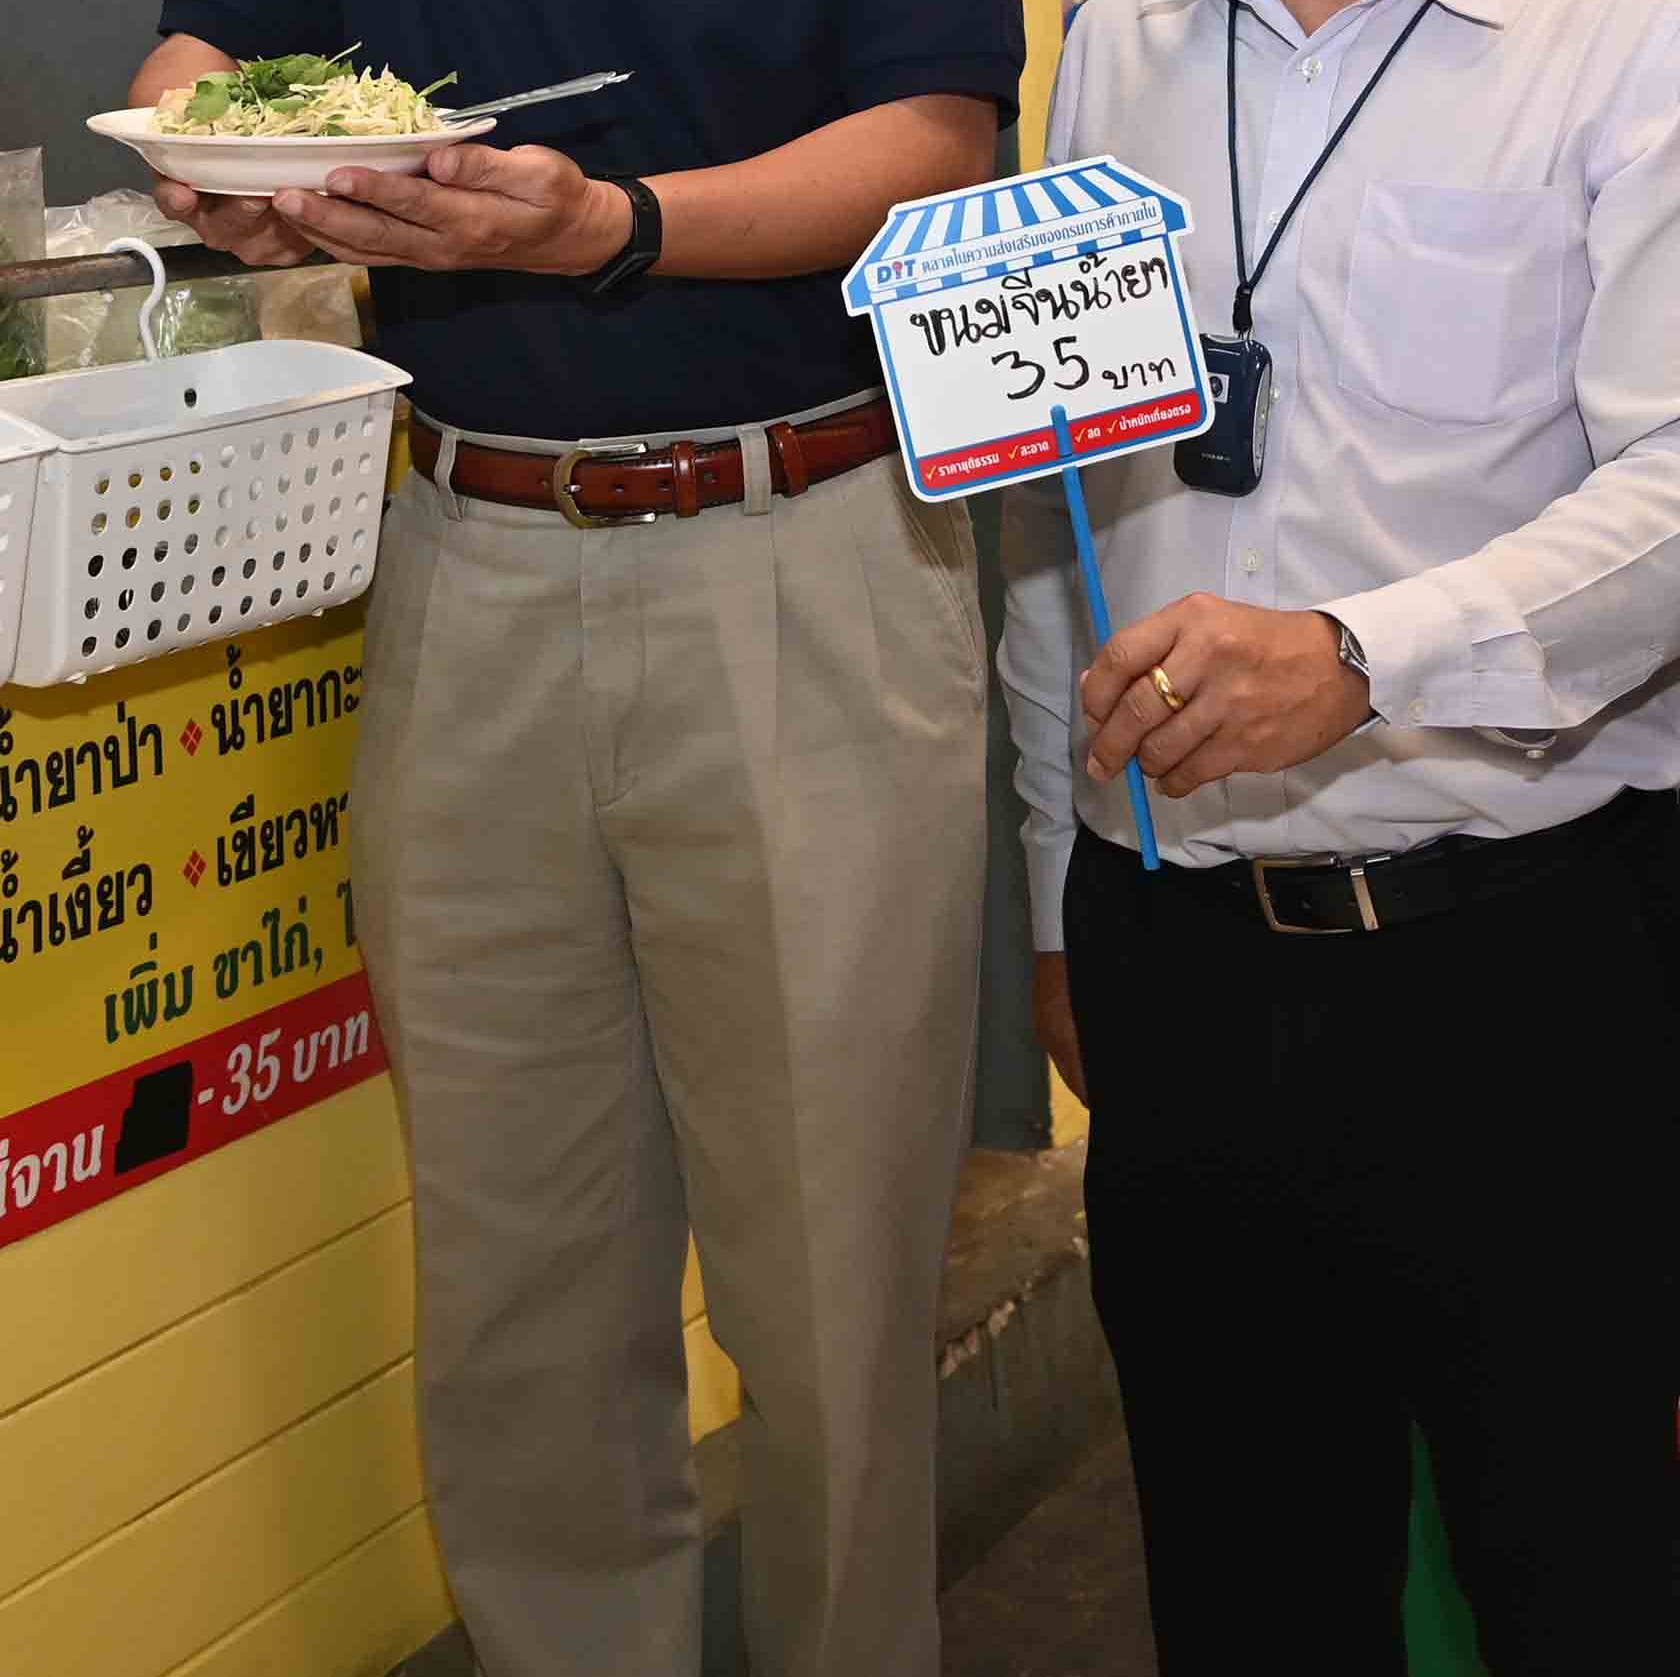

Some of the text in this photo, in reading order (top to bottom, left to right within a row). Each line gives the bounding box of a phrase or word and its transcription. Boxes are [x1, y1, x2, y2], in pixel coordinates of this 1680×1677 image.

[910, 252, 1168, 356] ขนมจีนน้ำยา
[991, 336, 1176, 400] 35 บาท
[938, 402, 1192, 477] ราคายุติธรรม สะอาด สด น้ำหนักเที่ยงตรง
[210, 644, 363, 756] น้ำยากะ
[216, 791, 351, 887] เขียวห
[104, 932, 195, 1044] เพิ่ม
[214, 896, 324, 999] ขาไก่,
[293, 1010, 370, 1083] บาท
